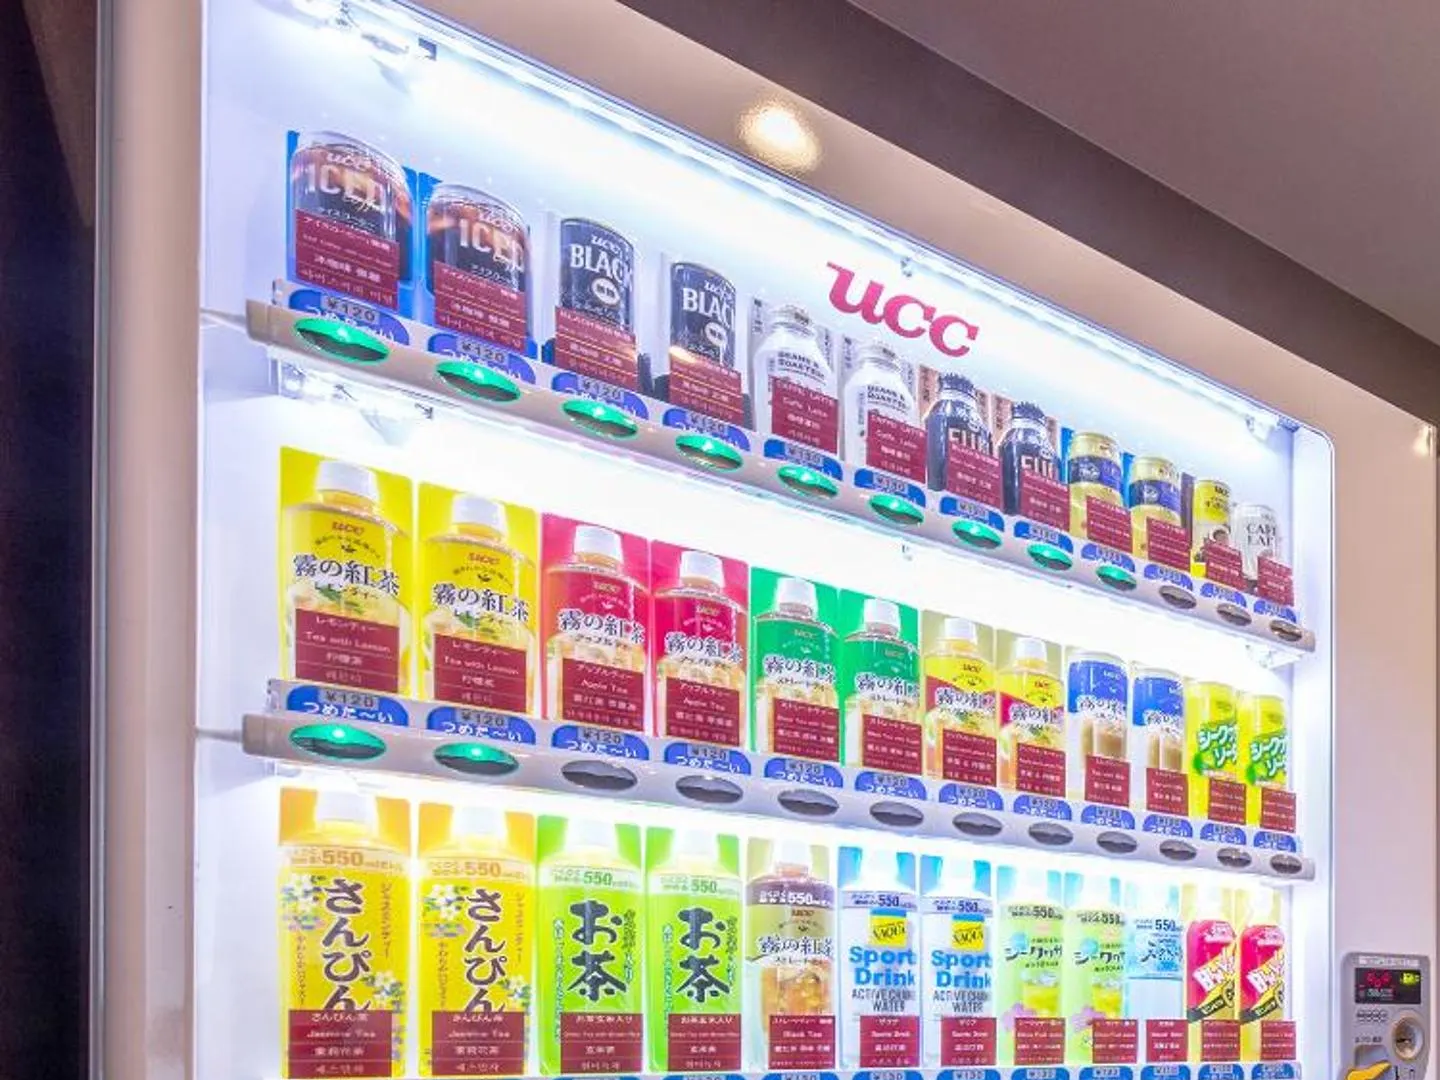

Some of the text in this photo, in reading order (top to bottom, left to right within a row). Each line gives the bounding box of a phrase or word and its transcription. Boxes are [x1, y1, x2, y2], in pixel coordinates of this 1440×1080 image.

[326, 297, 376, 322] ¥120
[682, 287, 736, 330] BLAC
[293, 553, 399, 596] 霧の紅茶
[433, 581, 529, 622] 霧の紅茶
[559, 608, 646, 644] 霧の紅茶
[326, 691, 375, 709] ¥120
[461, 710, 506, 727] ¥120
[581, 728, 622, 744] ¥120
[321, 850, 364, 867] 550
[464, 862, 501, 878] 550
[583, 871, 613, 886] 550
[320, 877, 373, 1012] さんぴん
[463, 888, 509, 1013] さんぴん
[567, 899, 628, 1003] お茶
[675, 907, 731, 1003] お茶
[850, 946, 917, 967] Sport
[930, 949, 993, 969] Sport
[854, 967, 916, 988] Drink
[936, 970, 992, 989] Drink
[872, 1000, 906, 1013] WATER
